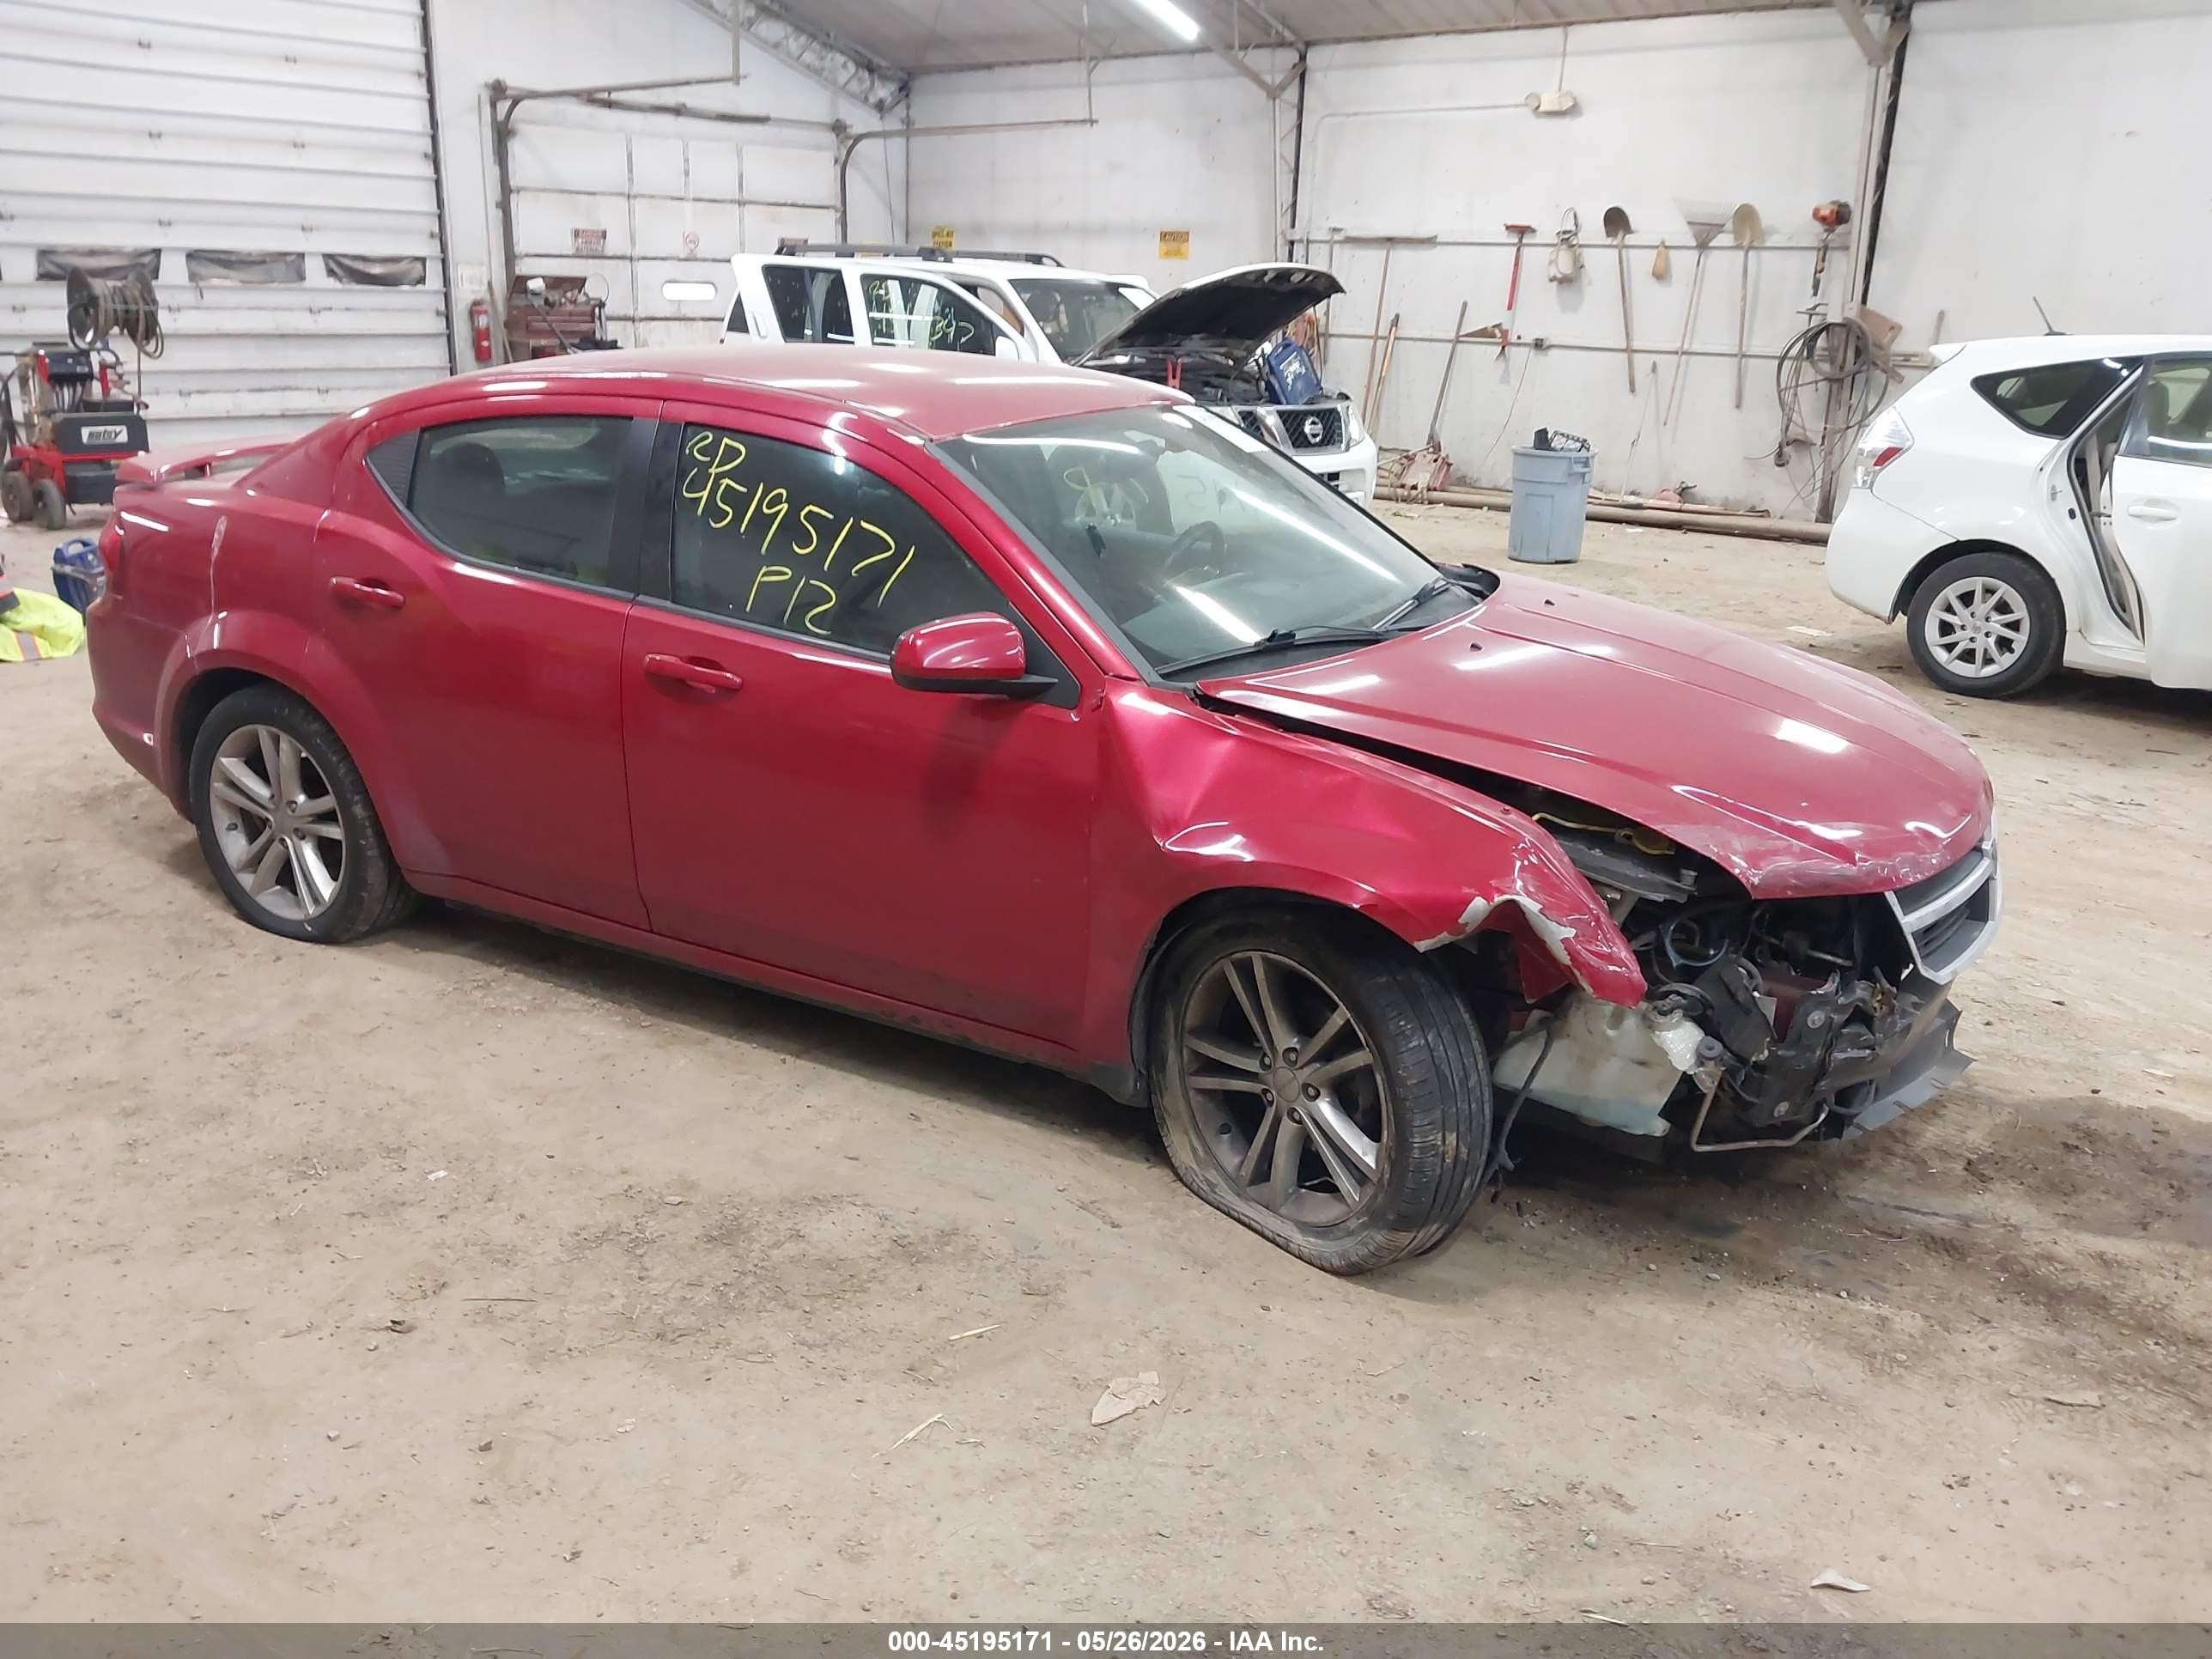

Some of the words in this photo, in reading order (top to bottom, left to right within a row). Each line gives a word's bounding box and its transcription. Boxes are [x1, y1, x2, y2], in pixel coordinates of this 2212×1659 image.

[1161, 232, 1188, 240] CAUTION
[683, 467, 915, 609] 45195171
[745, 565, 836, 635] P12
